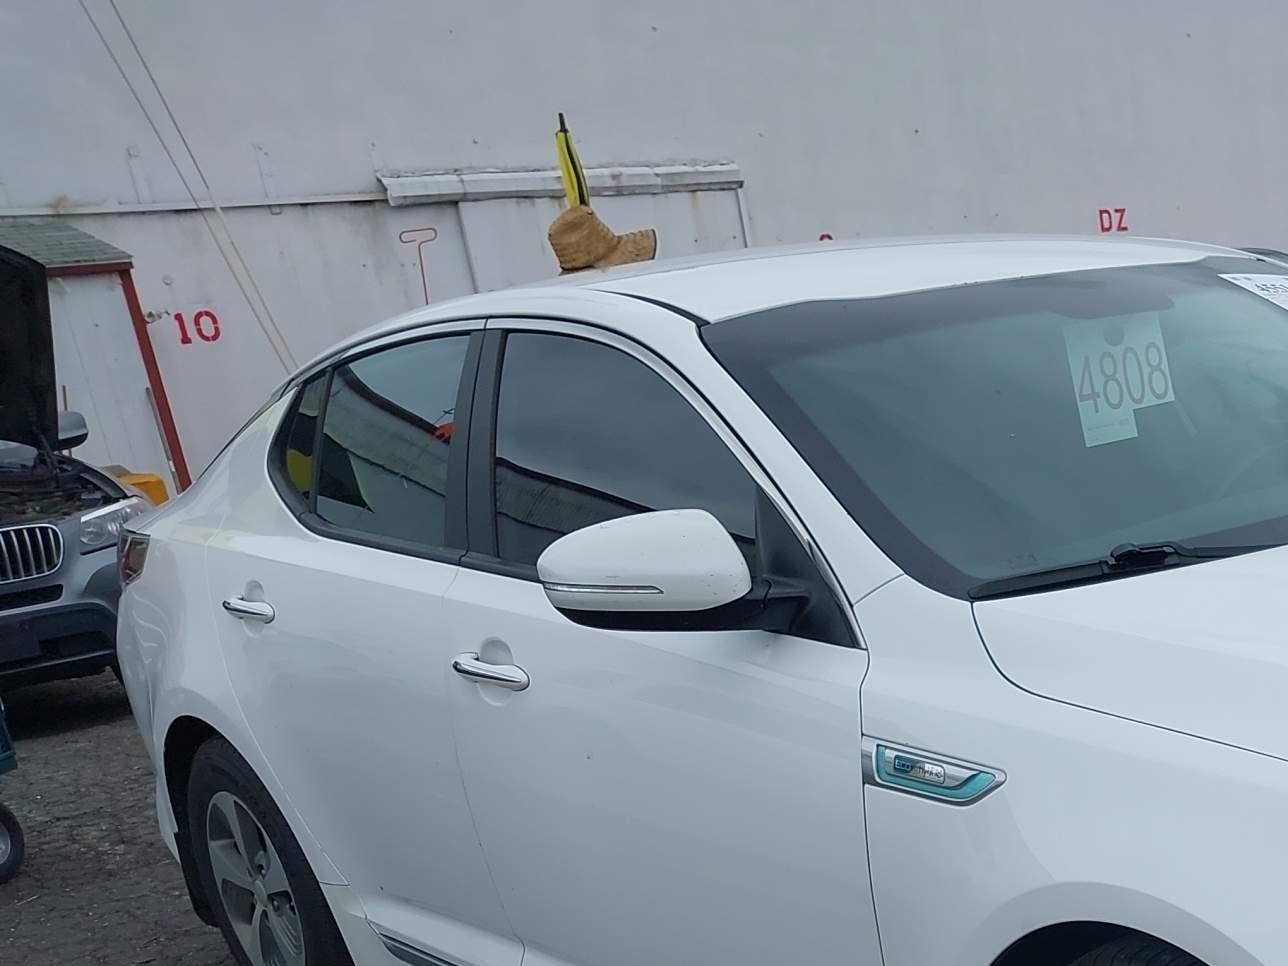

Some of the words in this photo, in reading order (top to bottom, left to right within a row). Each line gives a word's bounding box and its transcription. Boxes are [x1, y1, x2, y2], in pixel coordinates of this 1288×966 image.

[1098, 207, 1129, 233] DZ
[173, 310, 221, 345] 10
[1079, 341, 1170, 414] 4808
